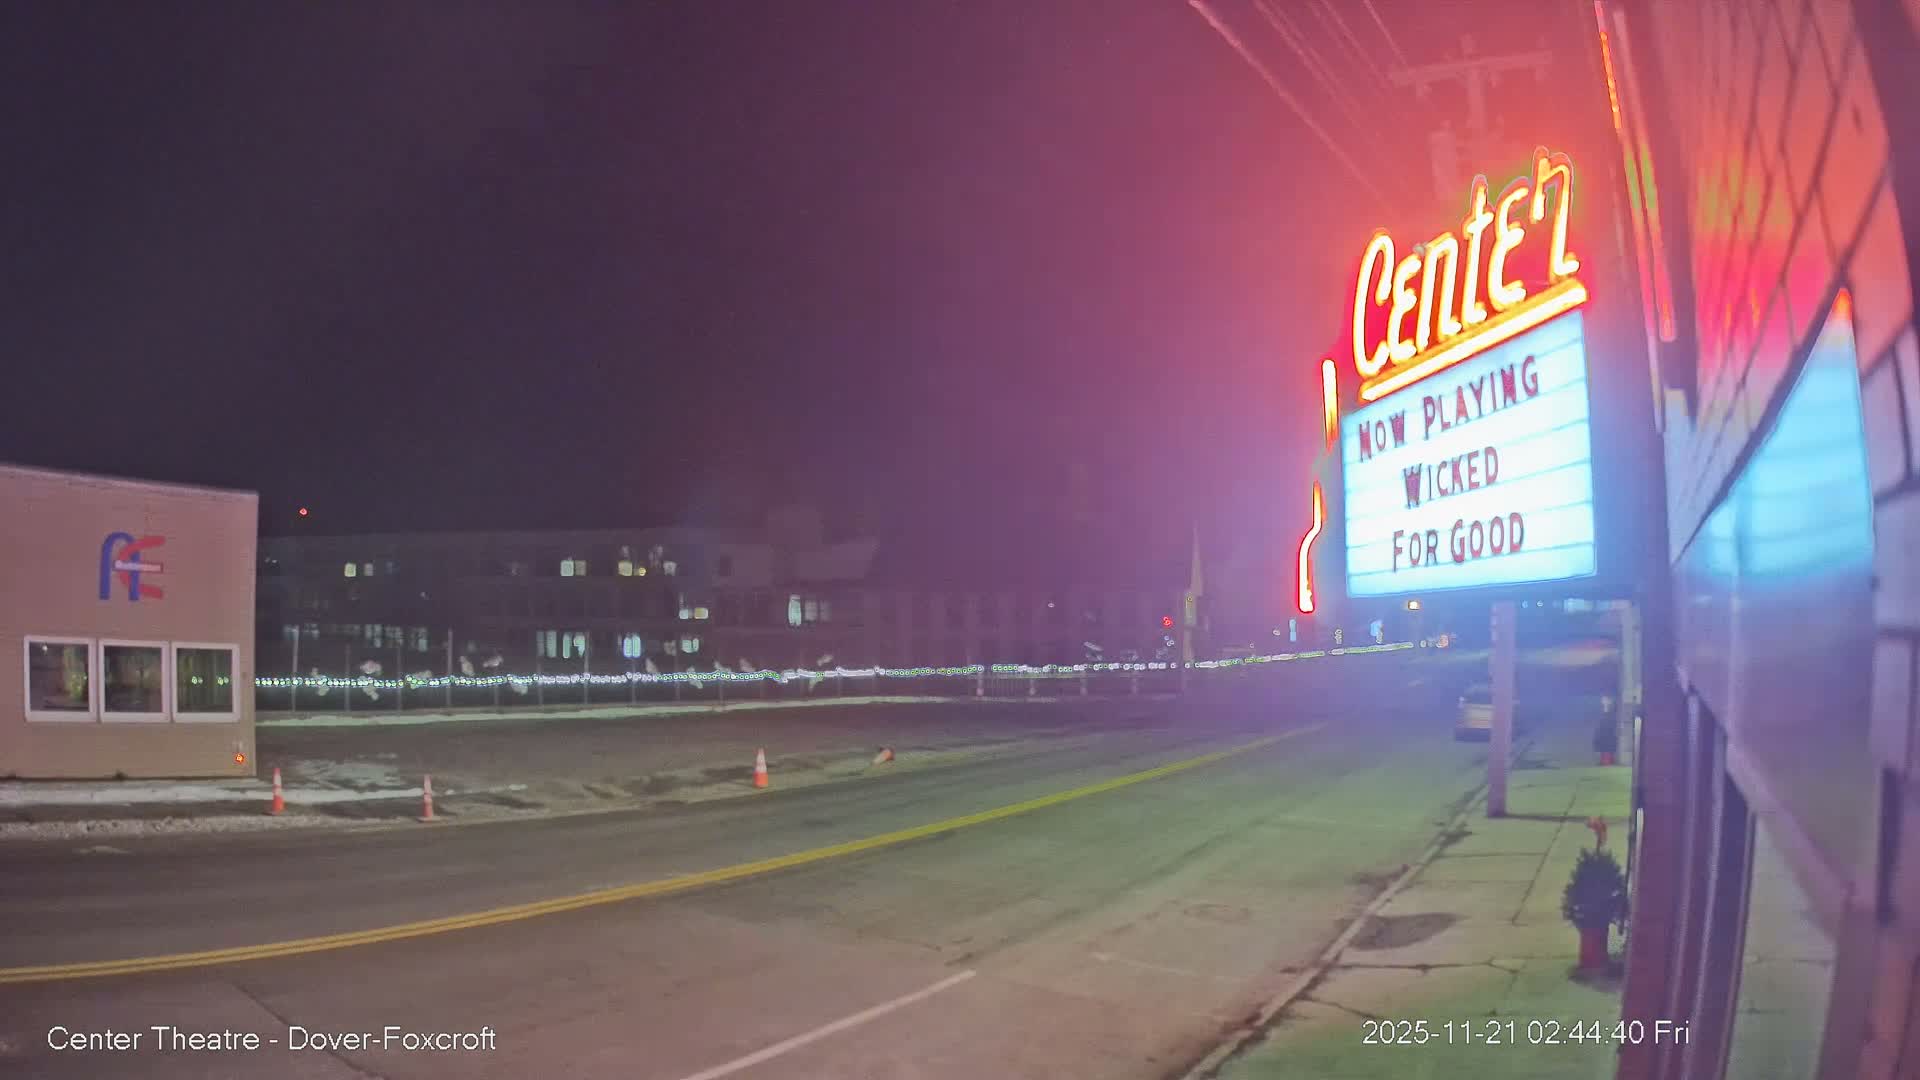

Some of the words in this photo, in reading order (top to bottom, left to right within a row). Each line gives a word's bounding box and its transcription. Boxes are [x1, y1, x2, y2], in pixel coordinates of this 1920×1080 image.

[1359, 412, 1406, 463] NOW
[1423, 355, 1539, 441] PLAYING
[1403, 446, 1499, 509] WICKED
[1393, 528, 1438, 572] FOR
[1449, 512, 1524, 564] GOOD
